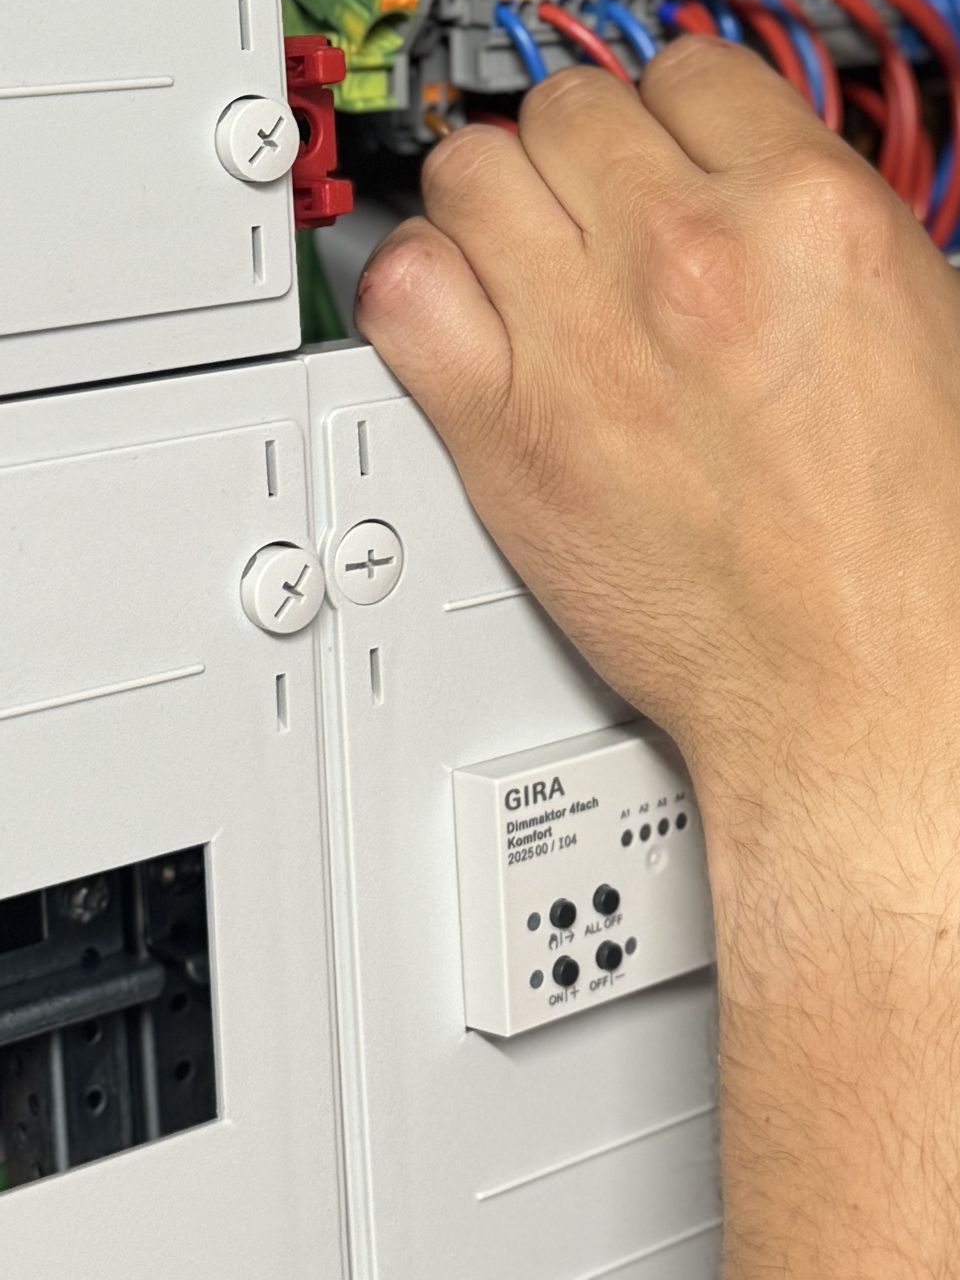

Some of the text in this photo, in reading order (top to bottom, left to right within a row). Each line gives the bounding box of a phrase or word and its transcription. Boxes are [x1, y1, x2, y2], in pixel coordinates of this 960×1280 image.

[504, 776, 565, 811] GIRA
[506, 796, 599, 835] Dimmaktor 4fach
[620, 808, 630, 820] A1
[507, 826, 552, 850] Komfort
[584, 913, 623, 936] ALL OFF
